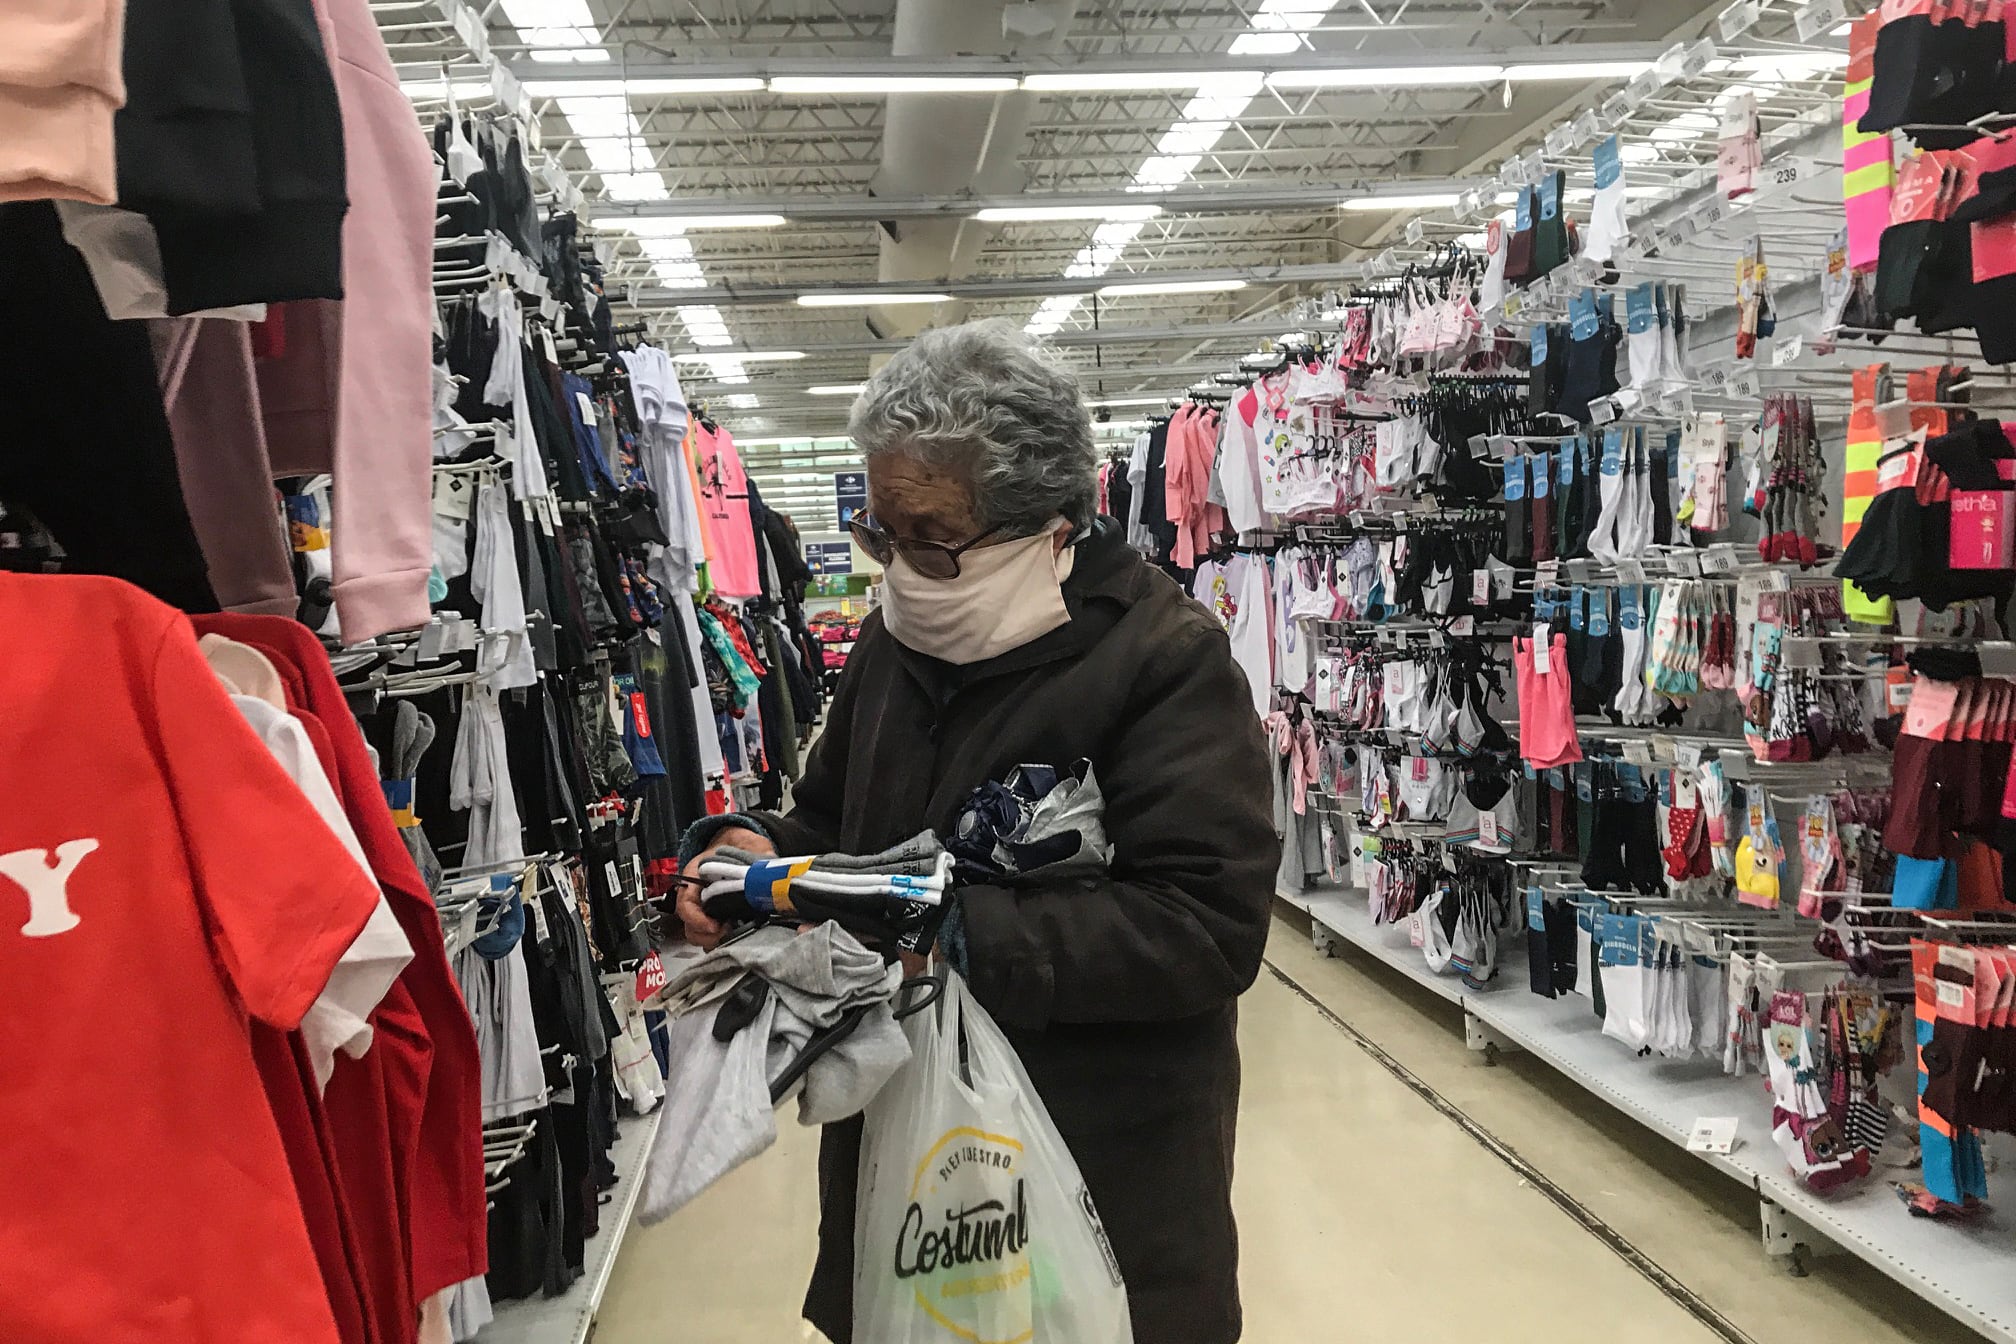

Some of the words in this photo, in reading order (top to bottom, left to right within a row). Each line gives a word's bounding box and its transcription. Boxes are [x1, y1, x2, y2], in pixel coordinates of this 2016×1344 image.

[1776, 168, 1797, 184] 239
[1711, 370, 1725, 386] 189
[1737, 381, 1751, 397] 189
[1715, 556, 1730, 570] 189
[0, 838, 99, 937] Y
